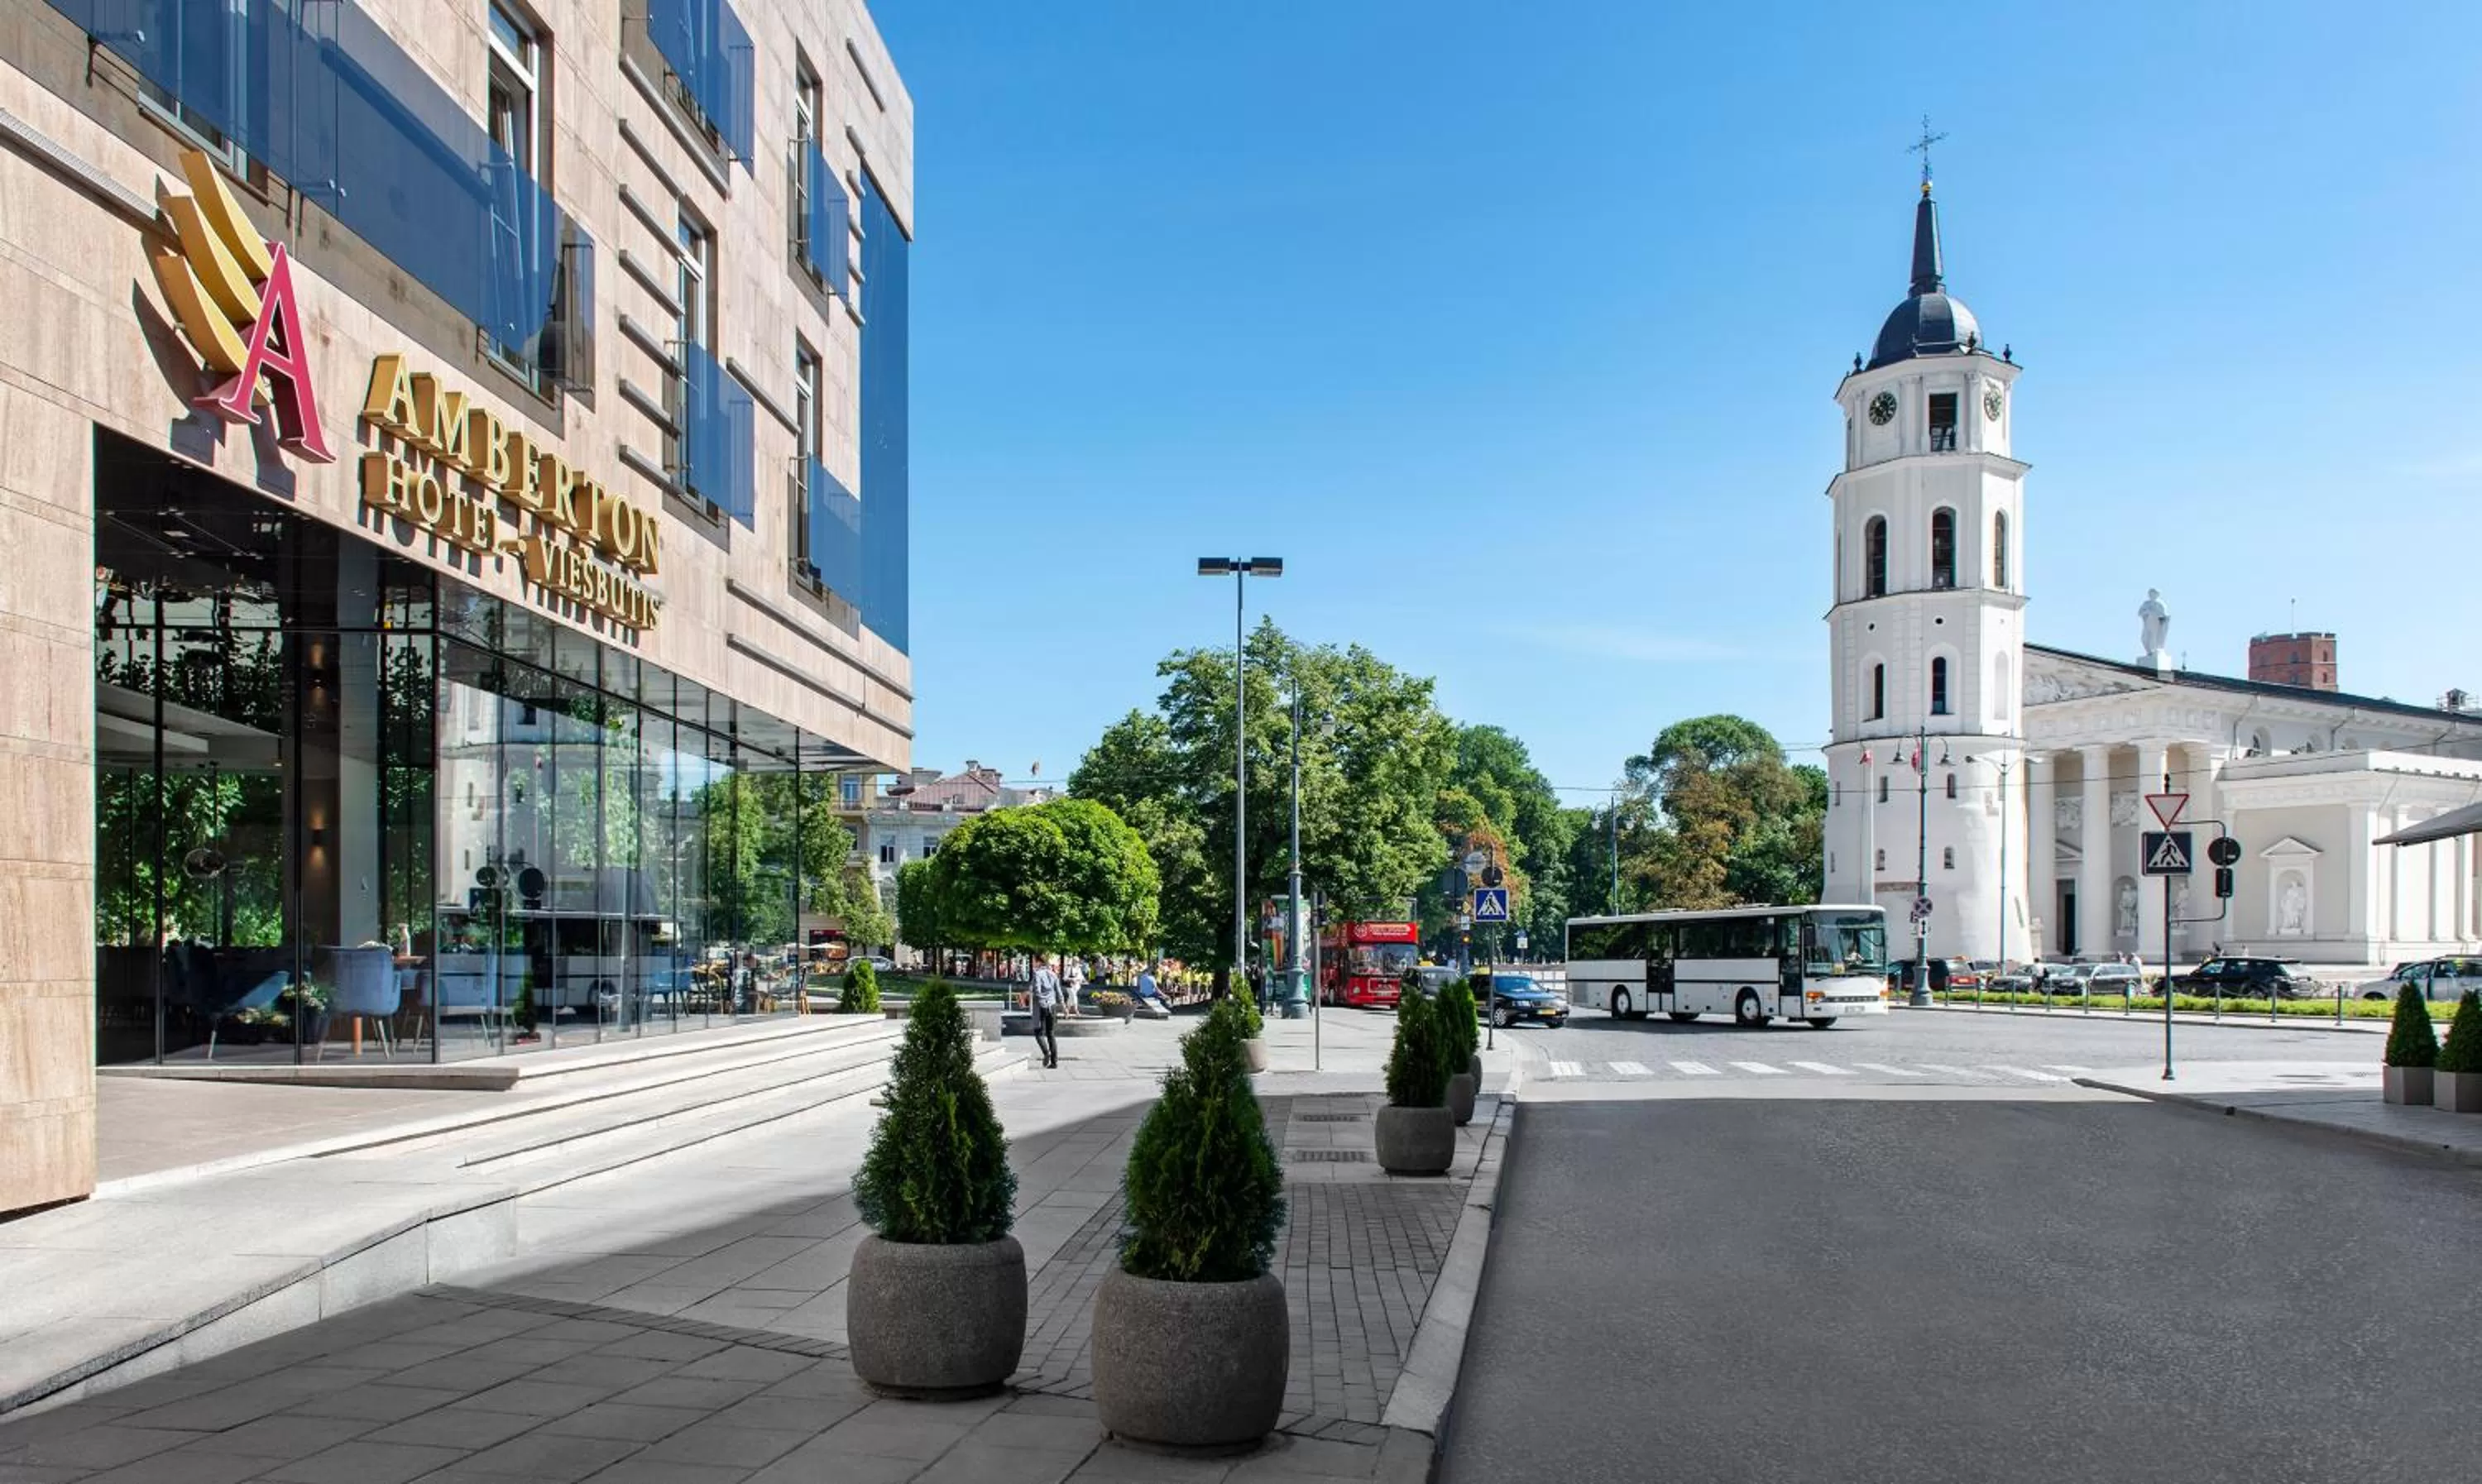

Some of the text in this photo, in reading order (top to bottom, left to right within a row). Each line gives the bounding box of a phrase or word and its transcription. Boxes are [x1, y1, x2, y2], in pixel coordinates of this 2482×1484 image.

[195, 241, 336, 464] A
[362, 352, 661, 574] AMBERTON
[366, 452, 508, 555] HOTEL
